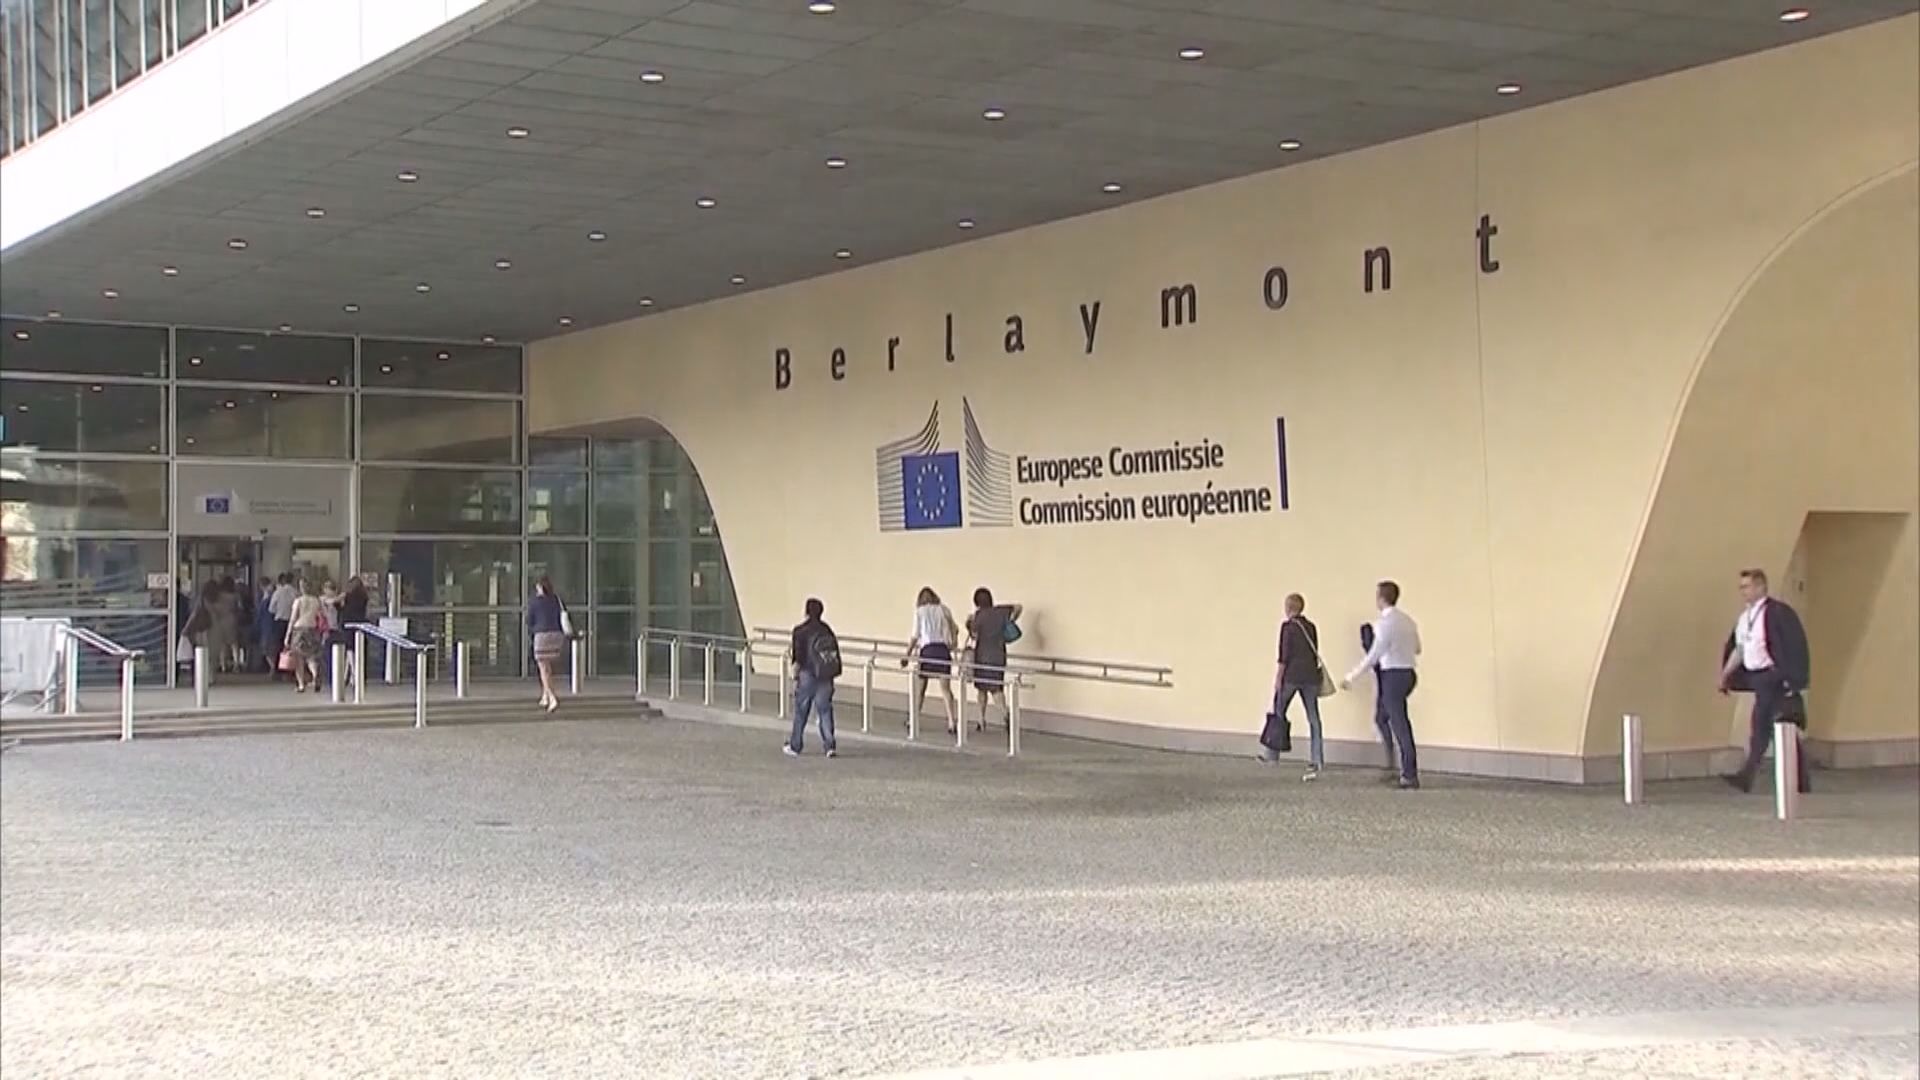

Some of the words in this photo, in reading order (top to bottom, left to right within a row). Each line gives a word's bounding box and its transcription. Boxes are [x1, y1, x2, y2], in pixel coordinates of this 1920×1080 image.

[775, 213, 1500, 390] Berlaymont
[1016, 455, 1103, 488] Europese
[1109, 437, 1225, 477] Commissie
[1019, 491, 1136, 526] Commission
[1142, 480, 1272, 524] européenne
